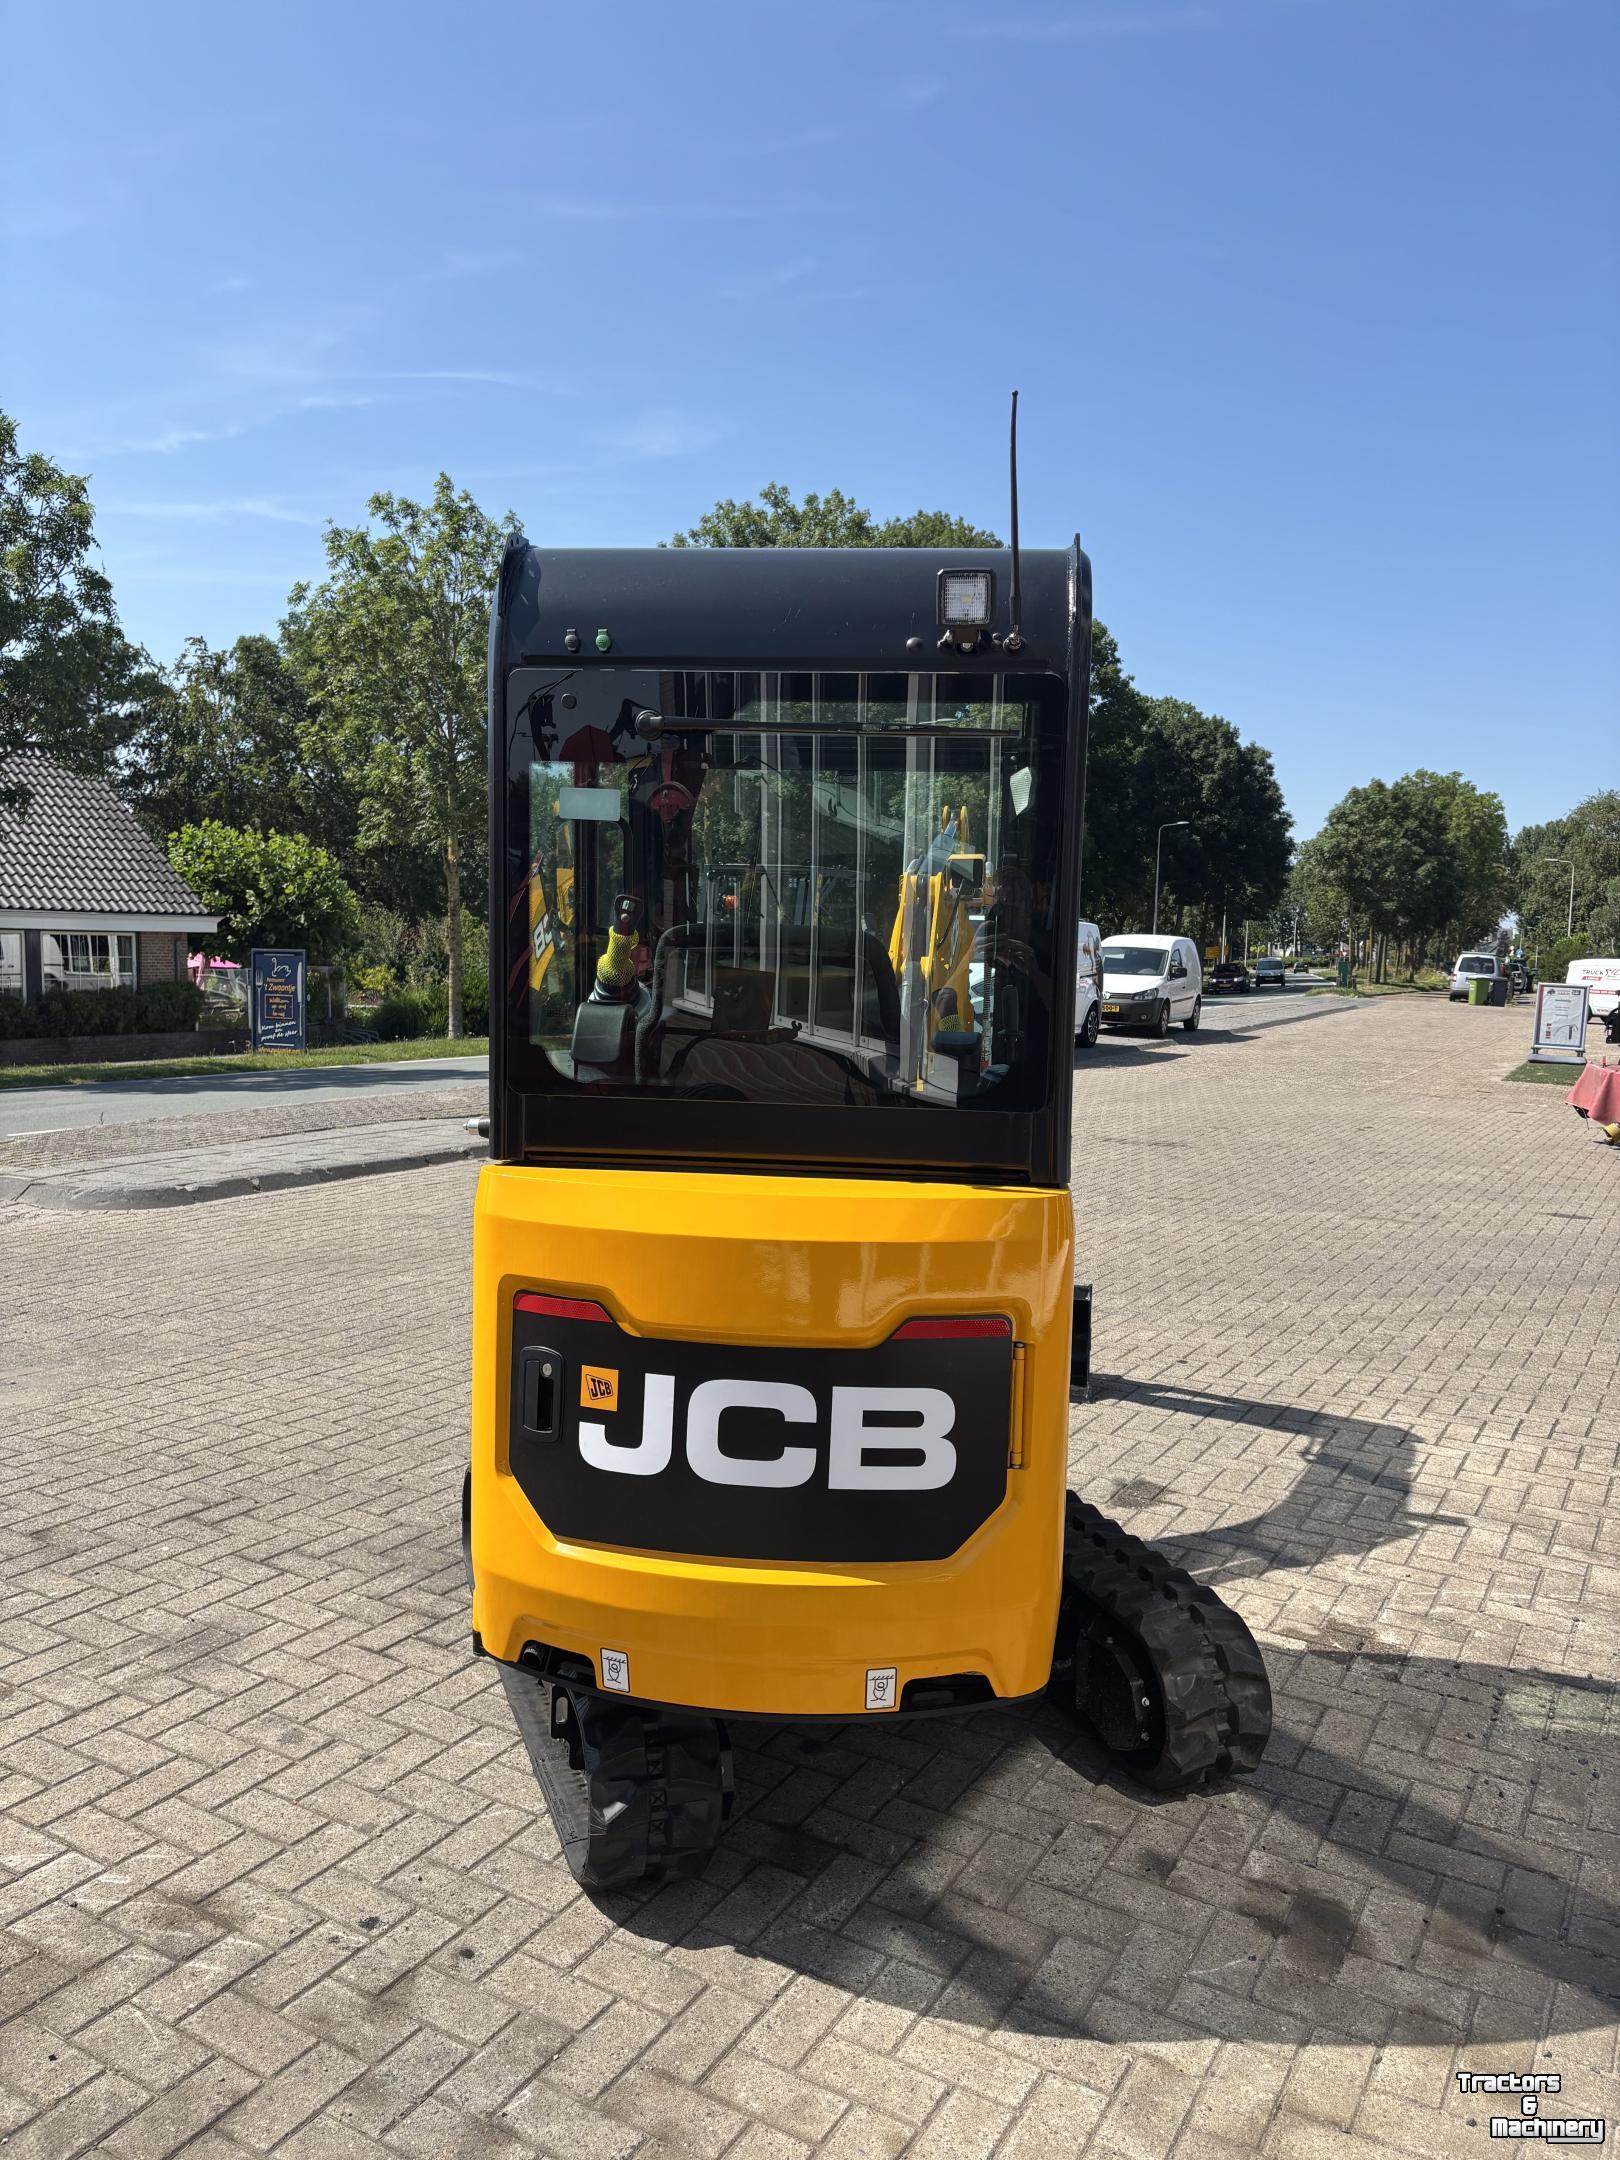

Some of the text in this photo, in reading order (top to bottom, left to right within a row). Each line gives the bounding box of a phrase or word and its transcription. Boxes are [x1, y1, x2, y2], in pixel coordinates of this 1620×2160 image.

[268, 983, 296, 993] Zwaantje
[590, 1377, 612, 1398] JCB
[579, 1373, 956, 1490] JCB
